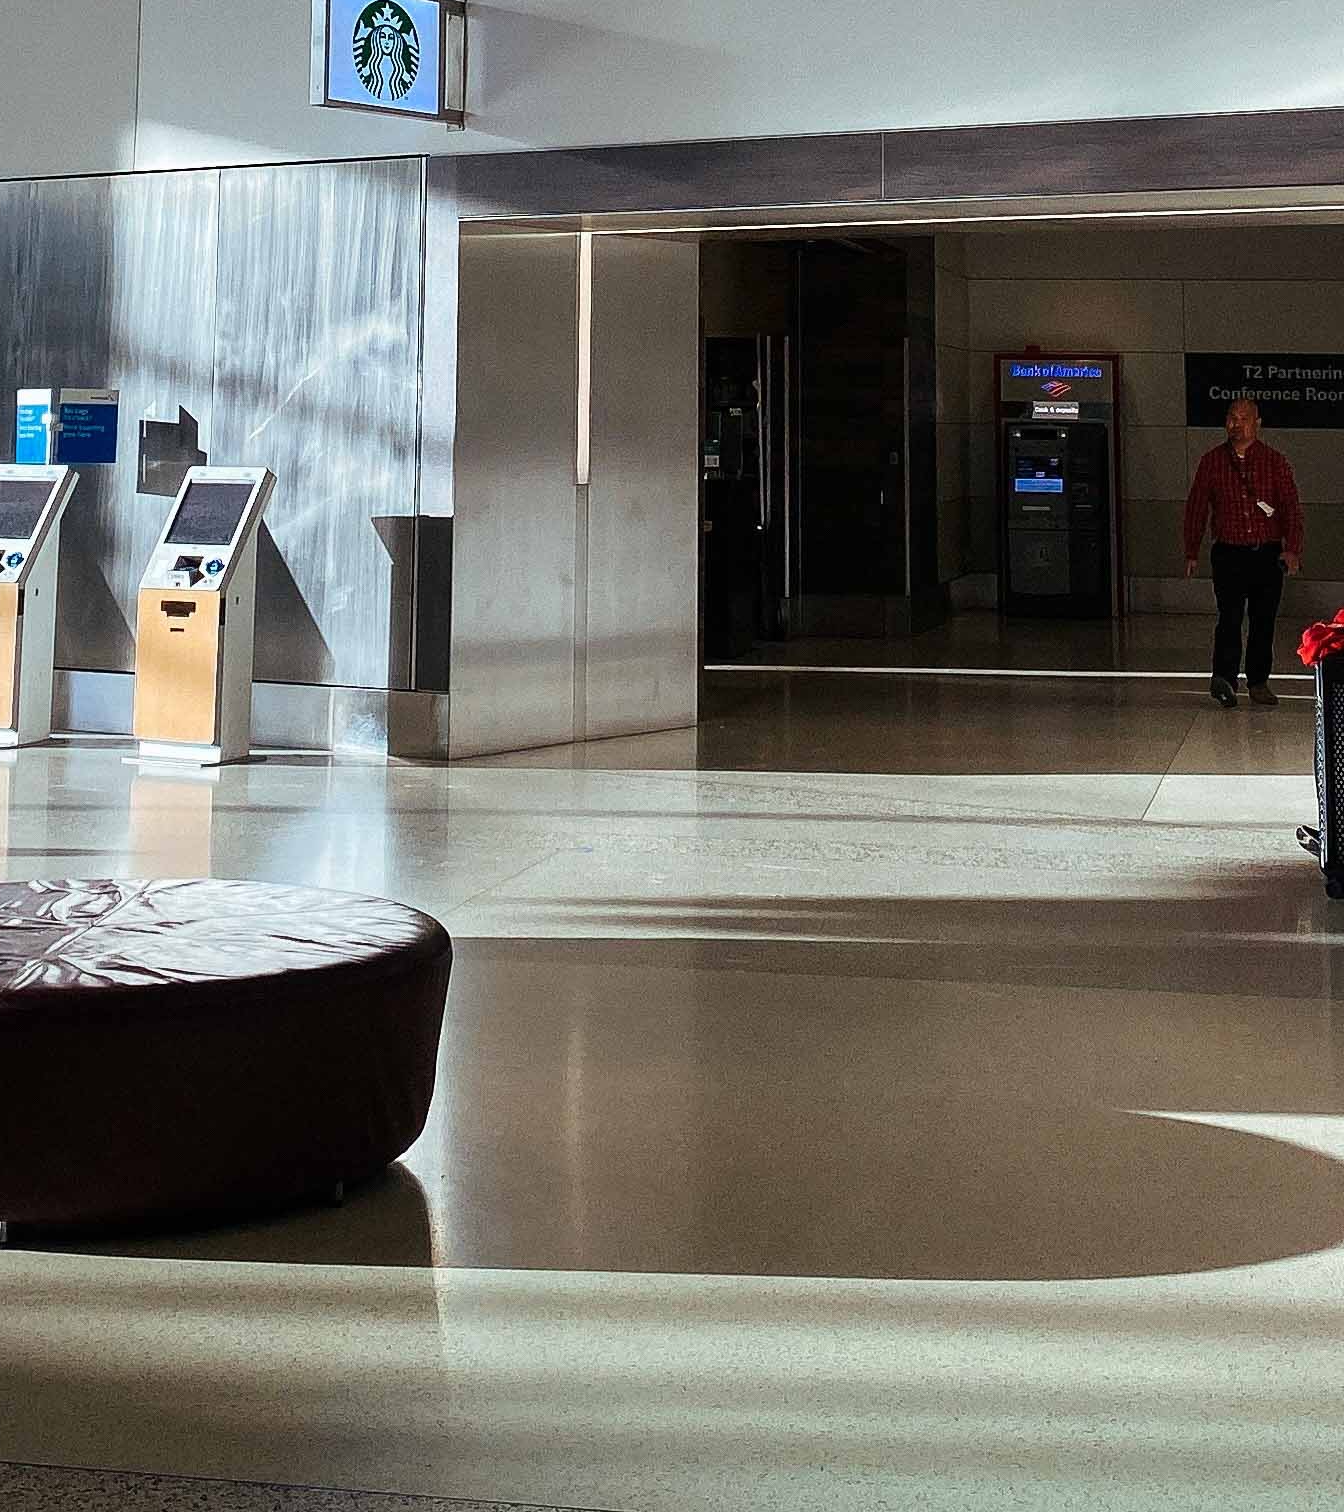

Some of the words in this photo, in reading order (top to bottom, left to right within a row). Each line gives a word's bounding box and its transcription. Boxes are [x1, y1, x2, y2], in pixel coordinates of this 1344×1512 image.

[1012, 364, 1041, 377] Bank
[1042, 364, 1054, 377] of
[1054, 365, 1102, 378] America
[1242, 364, 1264, 379] T2
[1208, 386, 1301, 401] Conference
